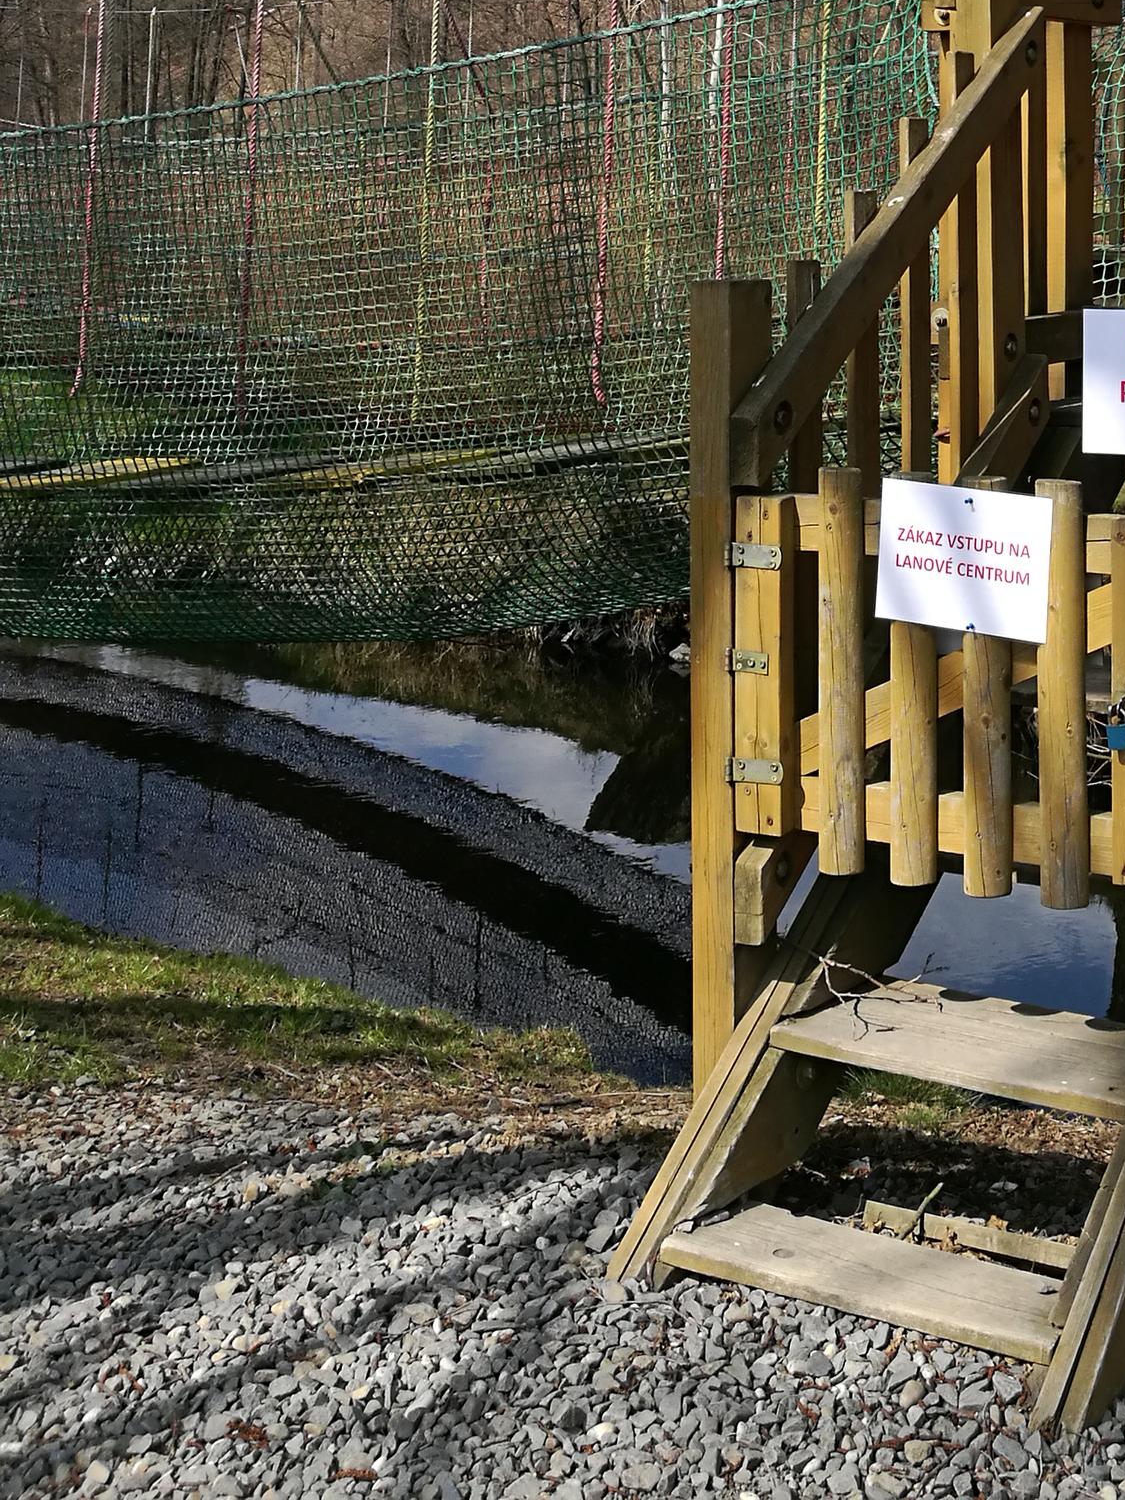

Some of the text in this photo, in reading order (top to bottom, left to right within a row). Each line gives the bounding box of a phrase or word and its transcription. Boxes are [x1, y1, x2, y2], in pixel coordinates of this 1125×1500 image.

[897, 525, 1031, 559] ZÁKAZ VSTUPU NA
[895, 553, 1031, 586] LANOVÉ CENTRUM
